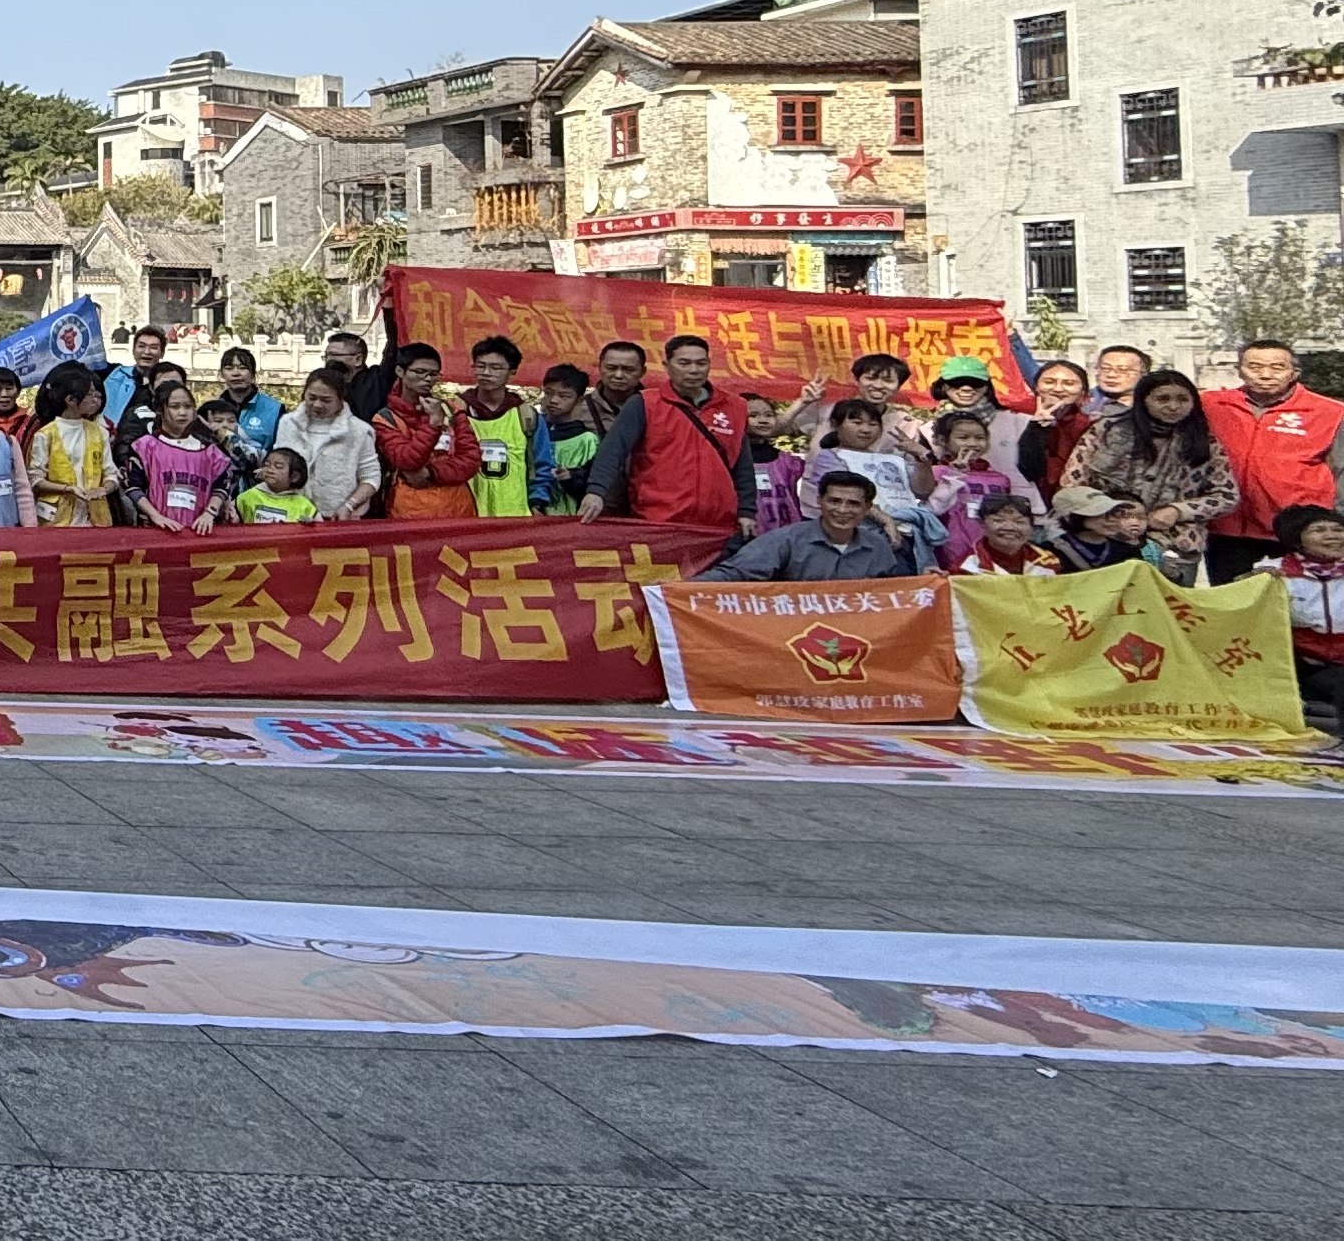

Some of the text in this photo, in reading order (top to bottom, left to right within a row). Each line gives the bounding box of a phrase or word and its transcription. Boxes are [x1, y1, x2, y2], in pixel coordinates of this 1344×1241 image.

[689, 587, 935, 616] 广州市番禺区关工委
